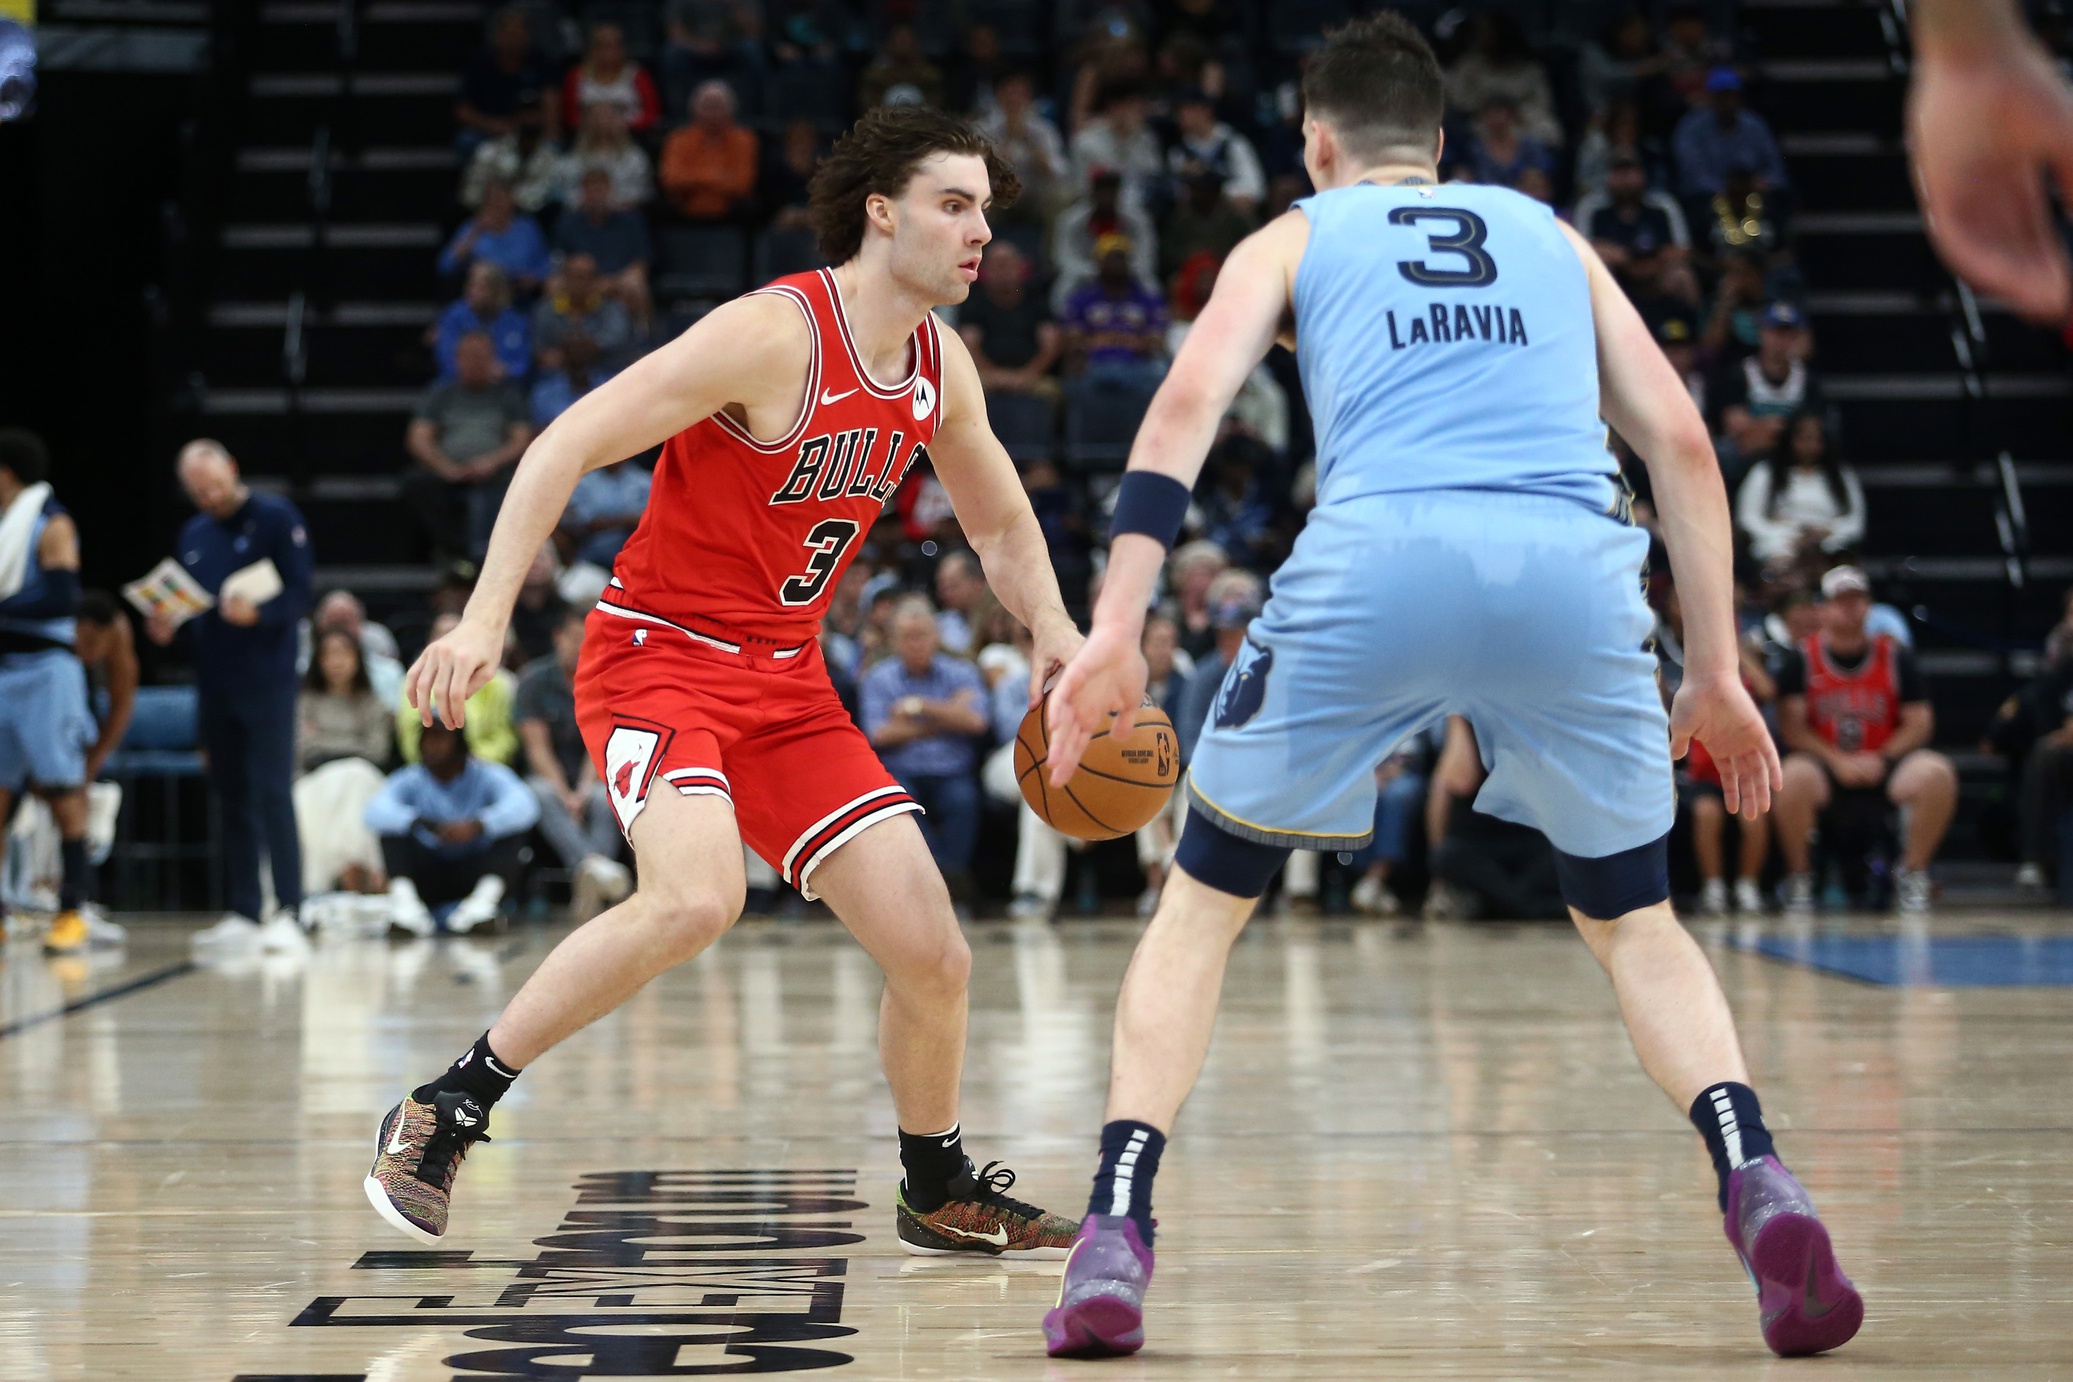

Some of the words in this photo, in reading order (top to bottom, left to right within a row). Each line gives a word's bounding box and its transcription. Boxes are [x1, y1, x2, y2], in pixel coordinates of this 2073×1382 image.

[1387, 206, 1498, 289] 3
[1386, 302, 1529, 351] LaRAVIA
[779, 517, 861, 607] 3
[231, 1169, 870, 1382] edExForum
